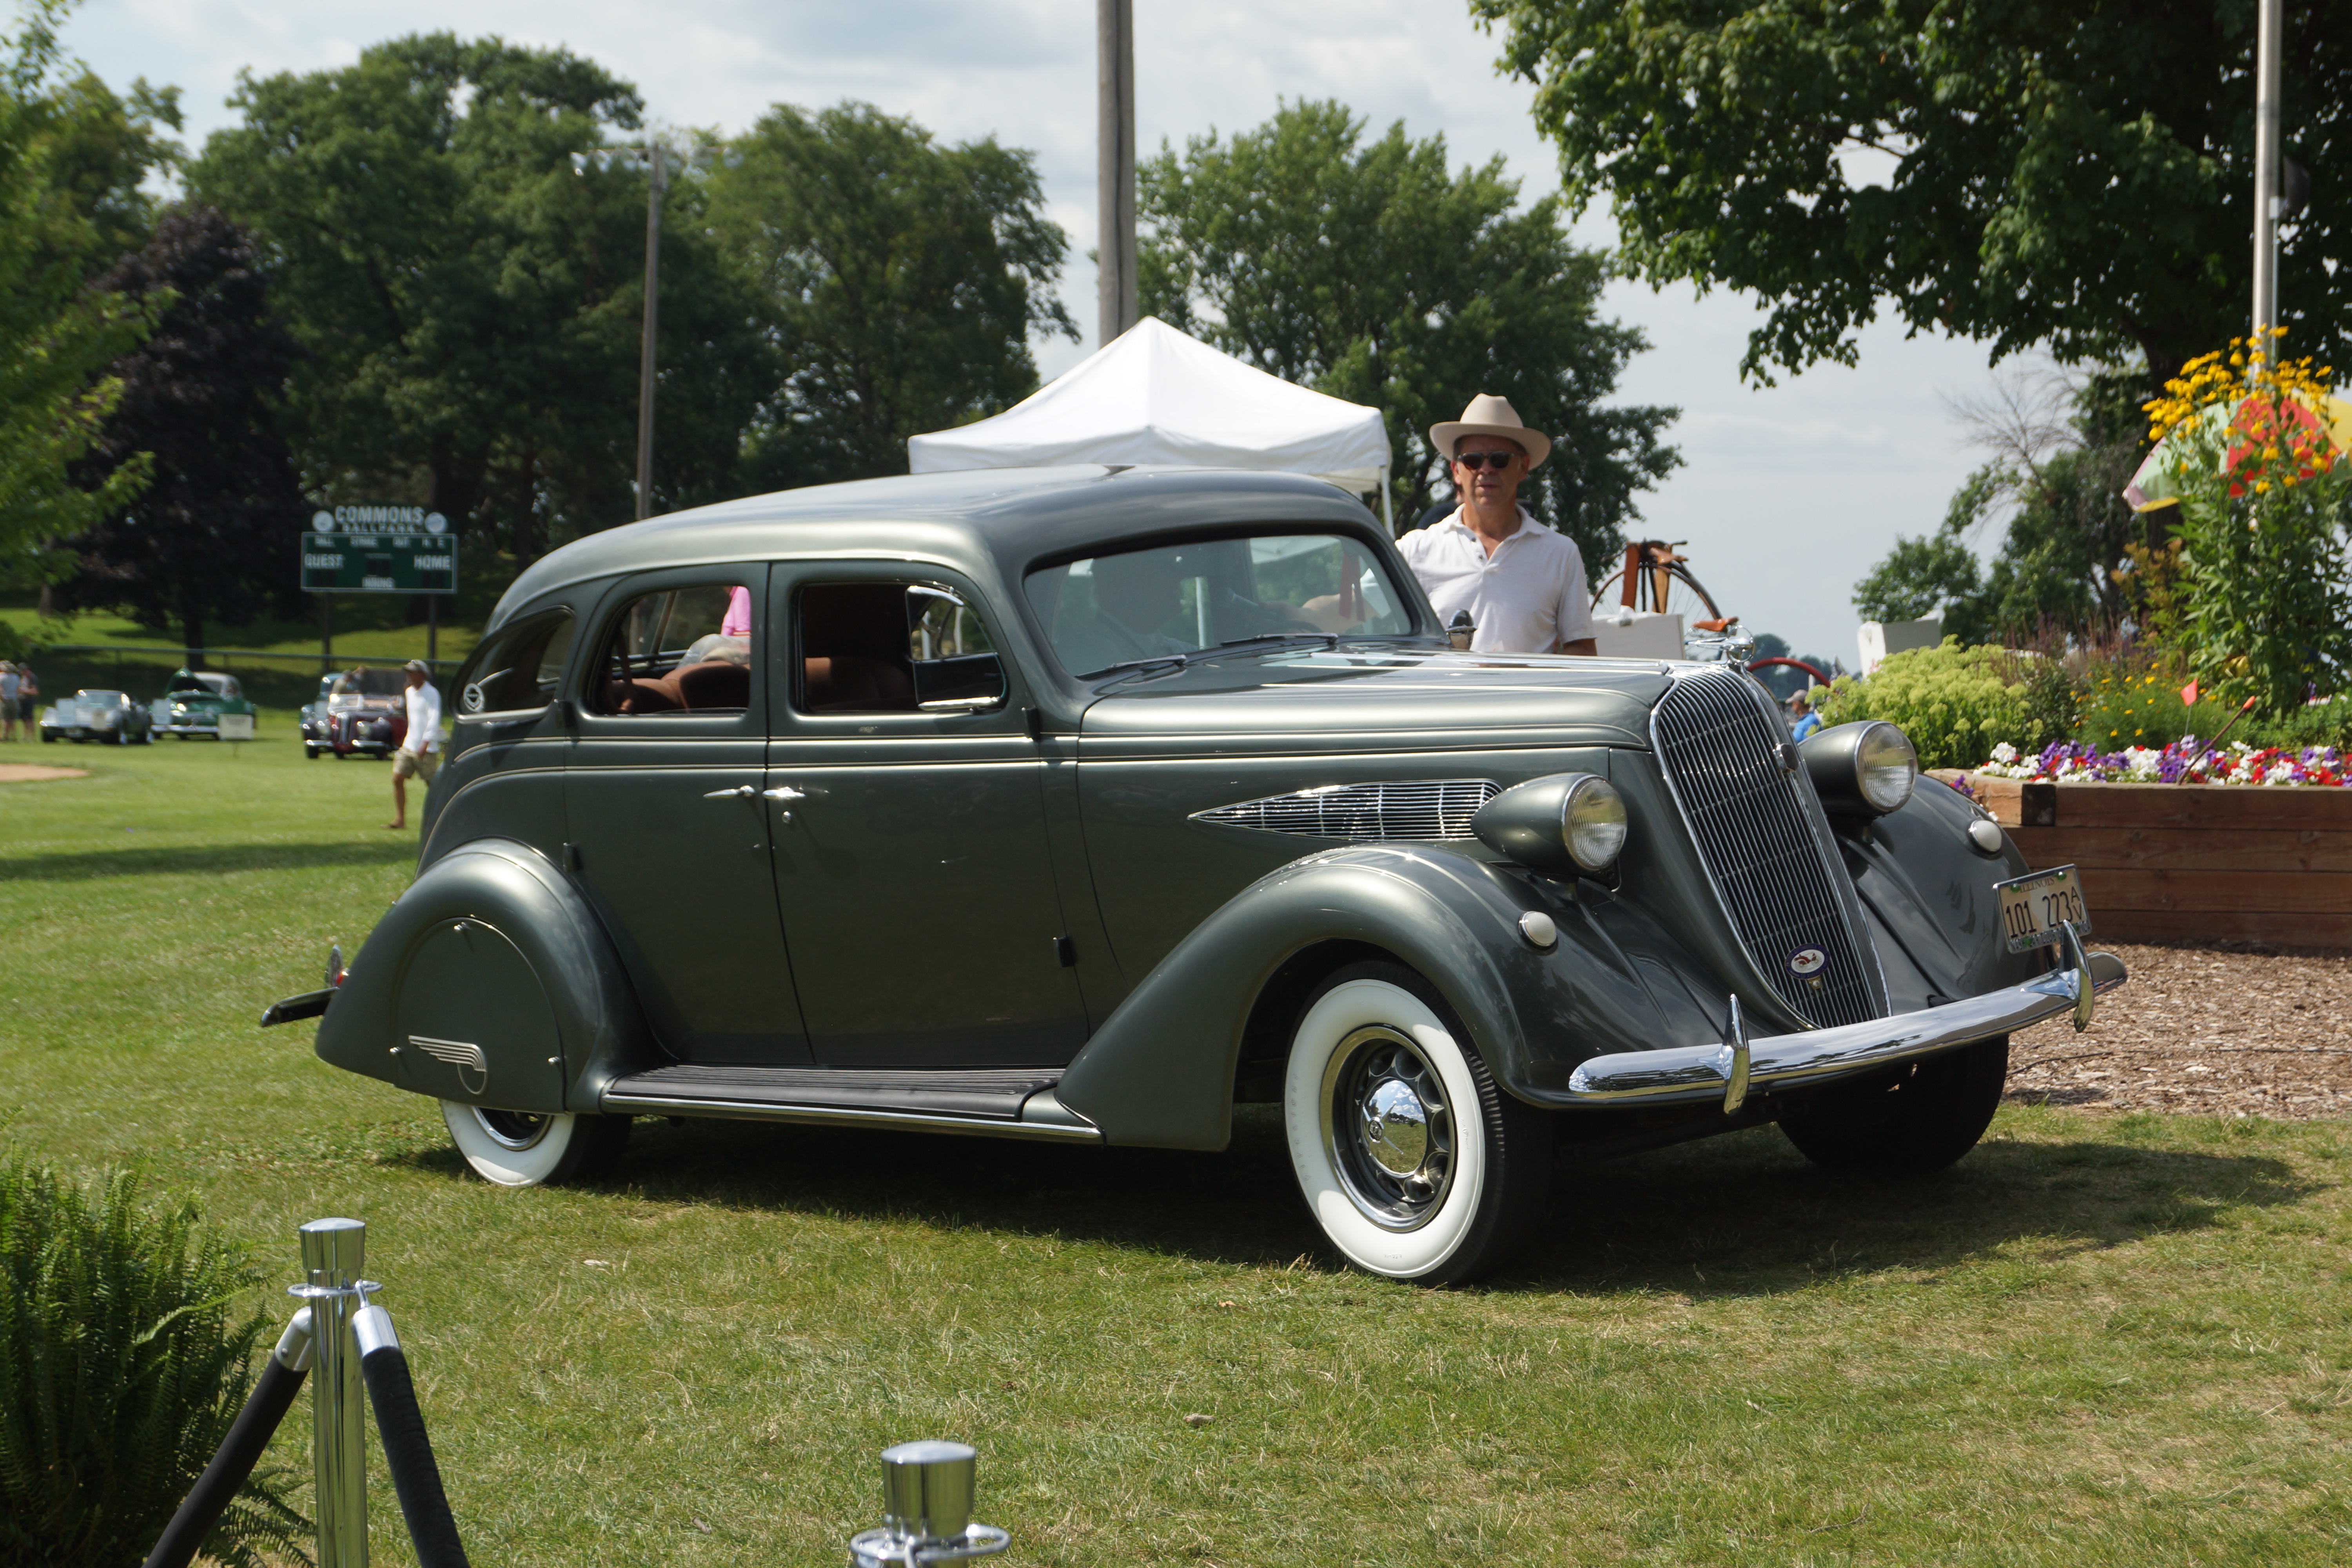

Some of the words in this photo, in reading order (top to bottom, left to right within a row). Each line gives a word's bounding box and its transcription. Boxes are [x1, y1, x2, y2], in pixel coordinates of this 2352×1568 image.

[335, 505, 425, 525] COMMONS
[341, 523, 416, 533] BALLPARK
[305, 554, 344, 569] GUEST
[414, 555, 452, 570] HOME
[2020, 877, 2055, 893] ILLINOIS
[2006, 900, 2037, 938] 101
[2042, 891, 2073, 927] 223
